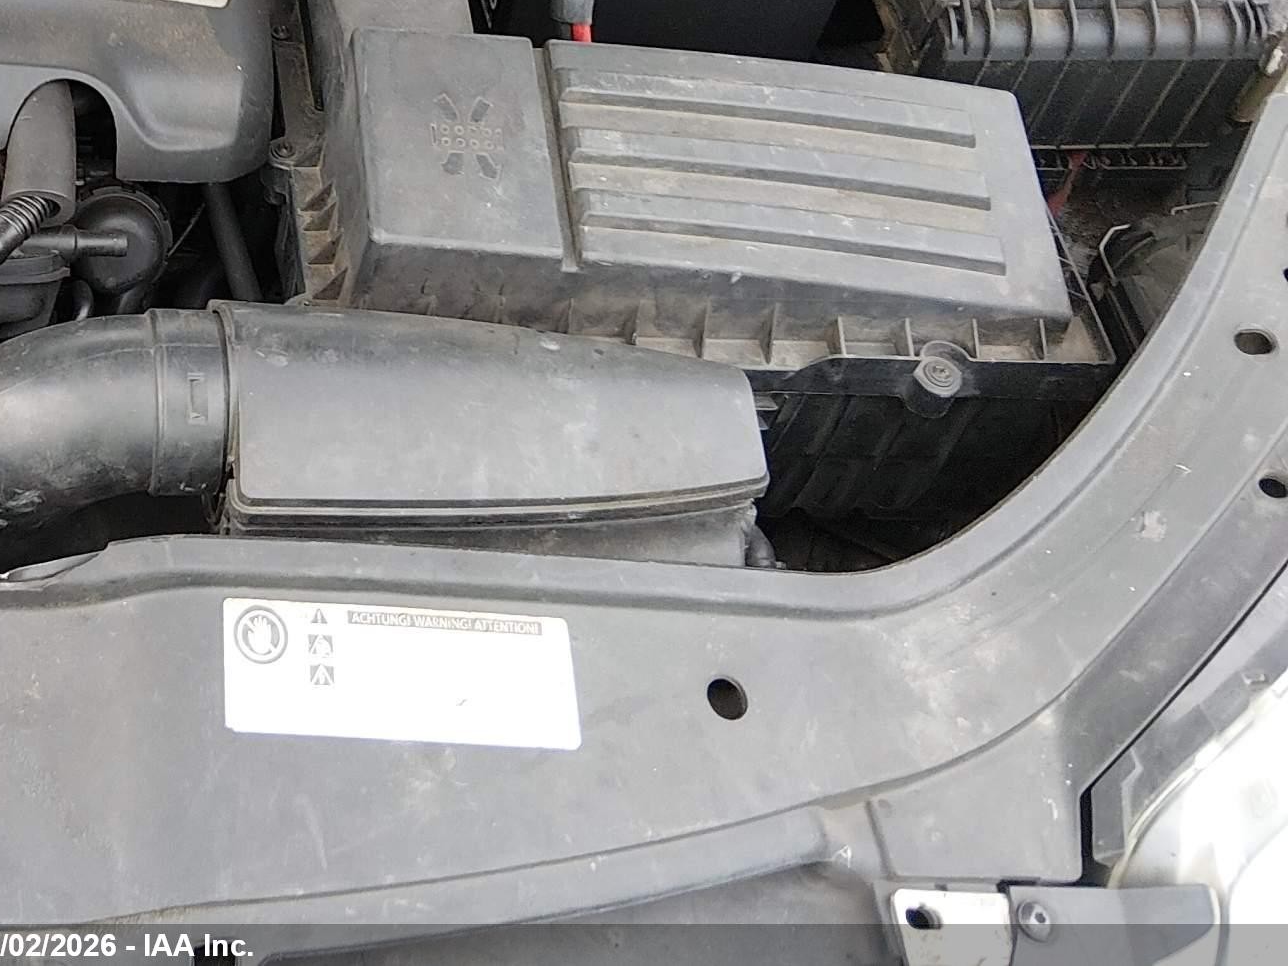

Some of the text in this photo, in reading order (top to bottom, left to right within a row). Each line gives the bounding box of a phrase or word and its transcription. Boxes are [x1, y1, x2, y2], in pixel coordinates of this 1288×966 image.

[351, 611, 540, 635] ACHTUNG! WARNING! ATTENTION!
